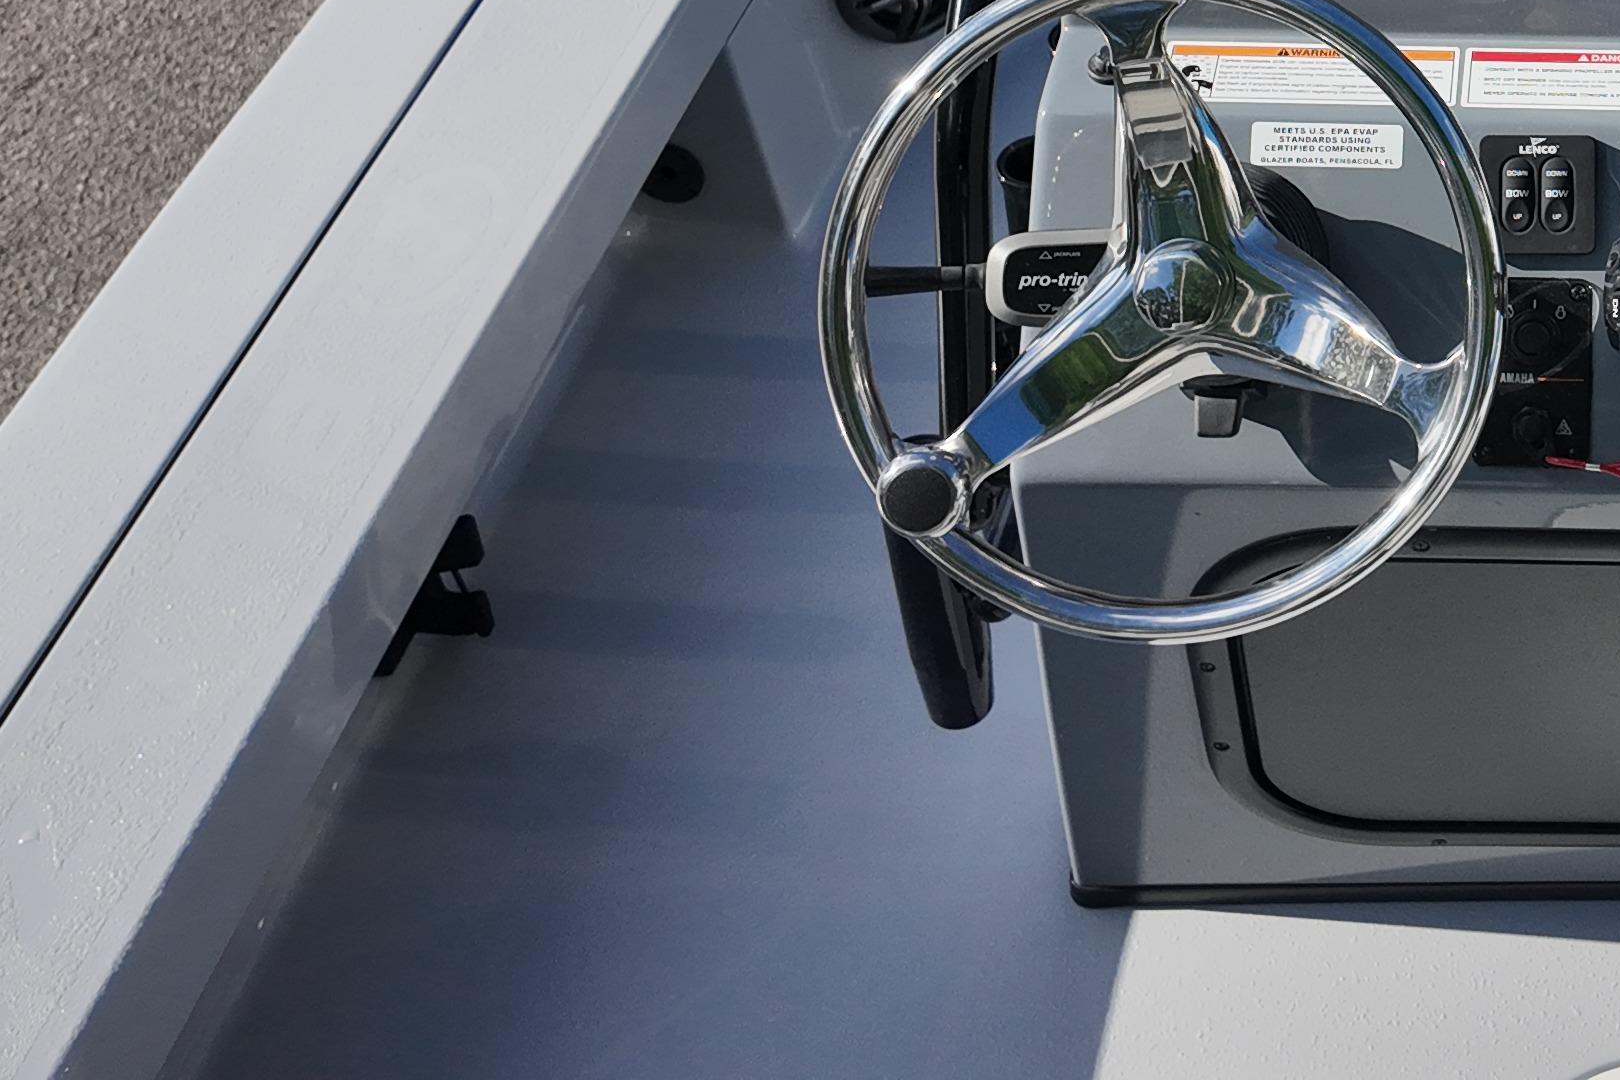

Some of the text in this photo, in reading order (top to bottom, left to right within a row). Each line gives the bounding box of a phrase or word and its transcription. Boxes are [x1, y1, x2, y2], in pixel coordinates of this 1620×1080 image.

[1290, 48, 1342, 57] WARNIN
[1273, 127, 1306, 135] MEETS
[1309, 127, 1327, 135] U.S.
[1353, 128, 1379, 136] EVAP
[1279, 136, 1371, 145] STANDARDS USING
[1264, 144, 1386, 154] CERTIFIED COMPONENTS
[1518, 145, 1558, 155] LENCO
[1545, 169, 1568, 177] DOWN
[1505, 189, 1530, 198] BOW
[1545, 189, 1569, 198] BOW
[1499, 372, 1535, 384] AMAHA
